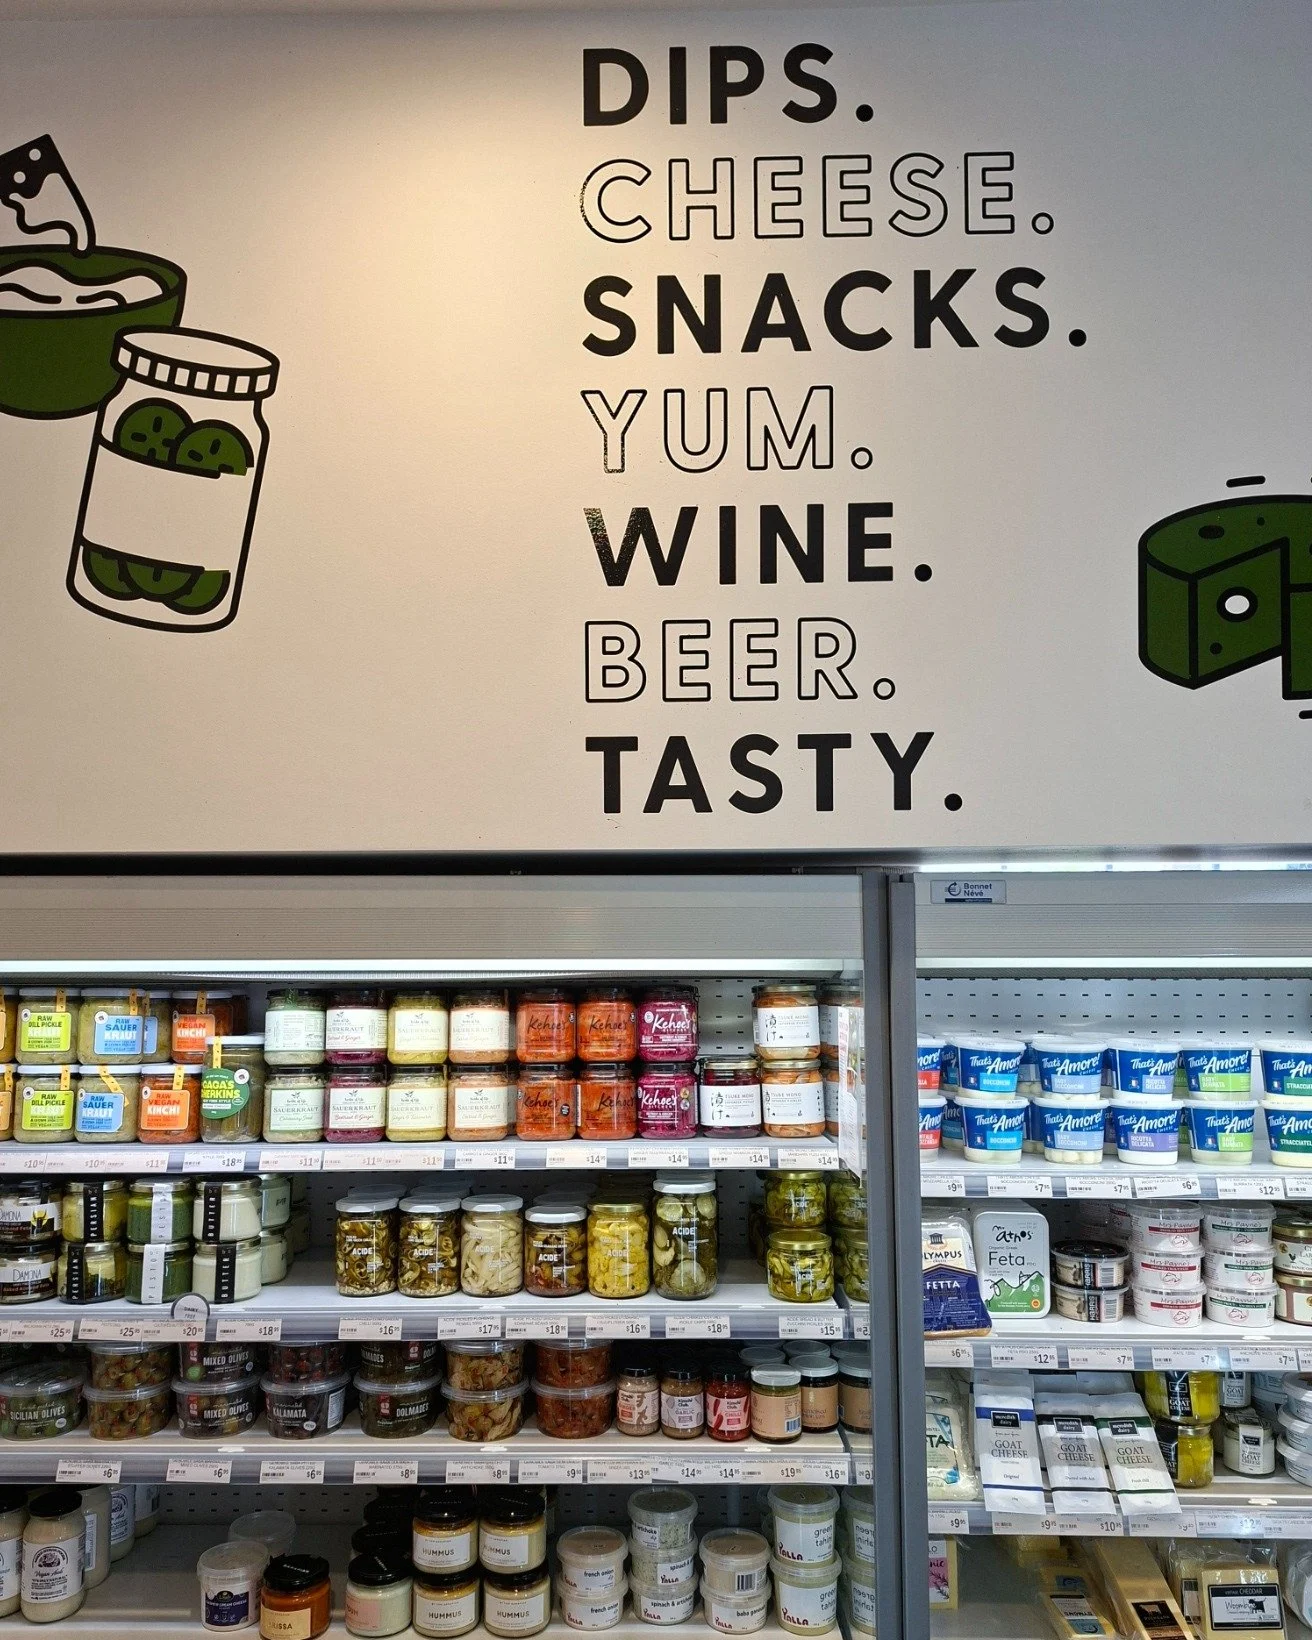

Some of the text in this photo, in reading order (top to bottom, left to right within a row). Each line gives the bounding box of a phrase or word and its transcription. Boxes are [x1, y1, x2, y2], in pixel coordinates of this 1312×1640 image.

[583, 43, 873, 126] DIPS.
[580, 151, 1054, 243] CHEESE.
[582, 267, 1087, 356] SNACKS.
[581, 385, 873, 473] YUM.
[583, 502, 932, 586] WINE.
[584, 617, 896, 703] BEER.
[585, 731, 963, 814] TASTY.
[105, 1031, 136, 1039] KRAUT
[970, 1056, 991, 1067] That's
[1042, 1053, 1100, 1075] That's Amore!
[1131, 1058, 1155, 1069] That's
[1188, 1051, 1248, 1075] That's Amore!
[1272, 1060, 1296, 1070] That's
[203, 1080, 234, 1089] GAGA'S
[82, 1109, 112, 1117] KRAUT
[975, 1114, 997, 1126] That's
[1044, 1111, 1102, 1131] That's Amore!
[1118, 1111, 1177, 1133] That's Amore!
[1205, 1115, 1230, 1127] That's
[1269, 1116, 1286, 1126] That's
[208, 1197, 216, 1237] BUTTER
[673, 1227, 695, 1235] ACIDE
[539, 1254, 558, 1262] ACIDE
[923, 1250, 962, 1260] LYMPUS
[988, 1252, 1024, 1266] Feta
[13, 1269, 42, 1282] DAMONA
[221, 1257, 229, 1297] BUTTER
[927, 1281, 960, 1289] FETTA
[203, 1352, 249, 1366] MIXED OLIVES
[10, 1406, 65, 1420] SICILIAN OLIVES
[204, 1402, 249, 1418] MIXED OLIVES
[272, 1407, 307, 1418] KALAMATA
[396, 1404, 429, 1417] DOLMADES
[995, 1440, 1022, 1448] GOAT
[1060, 1444, 1088, 1452] GOAT
[991, 1449, 1028, 1458] CHEESE
[1058, 1453, 1095, 1461] CHEESE
[1118, 1447, 1145, 1455] GOAT
[1117, 1455, 1152, 1464] CHEESE
[814, 1525, 832, 1537] green
[816, 1537, 832, 1547] tahini
[670, 1563, 685, 1571] spinach
[607, 1603, 618, 1611] onion
